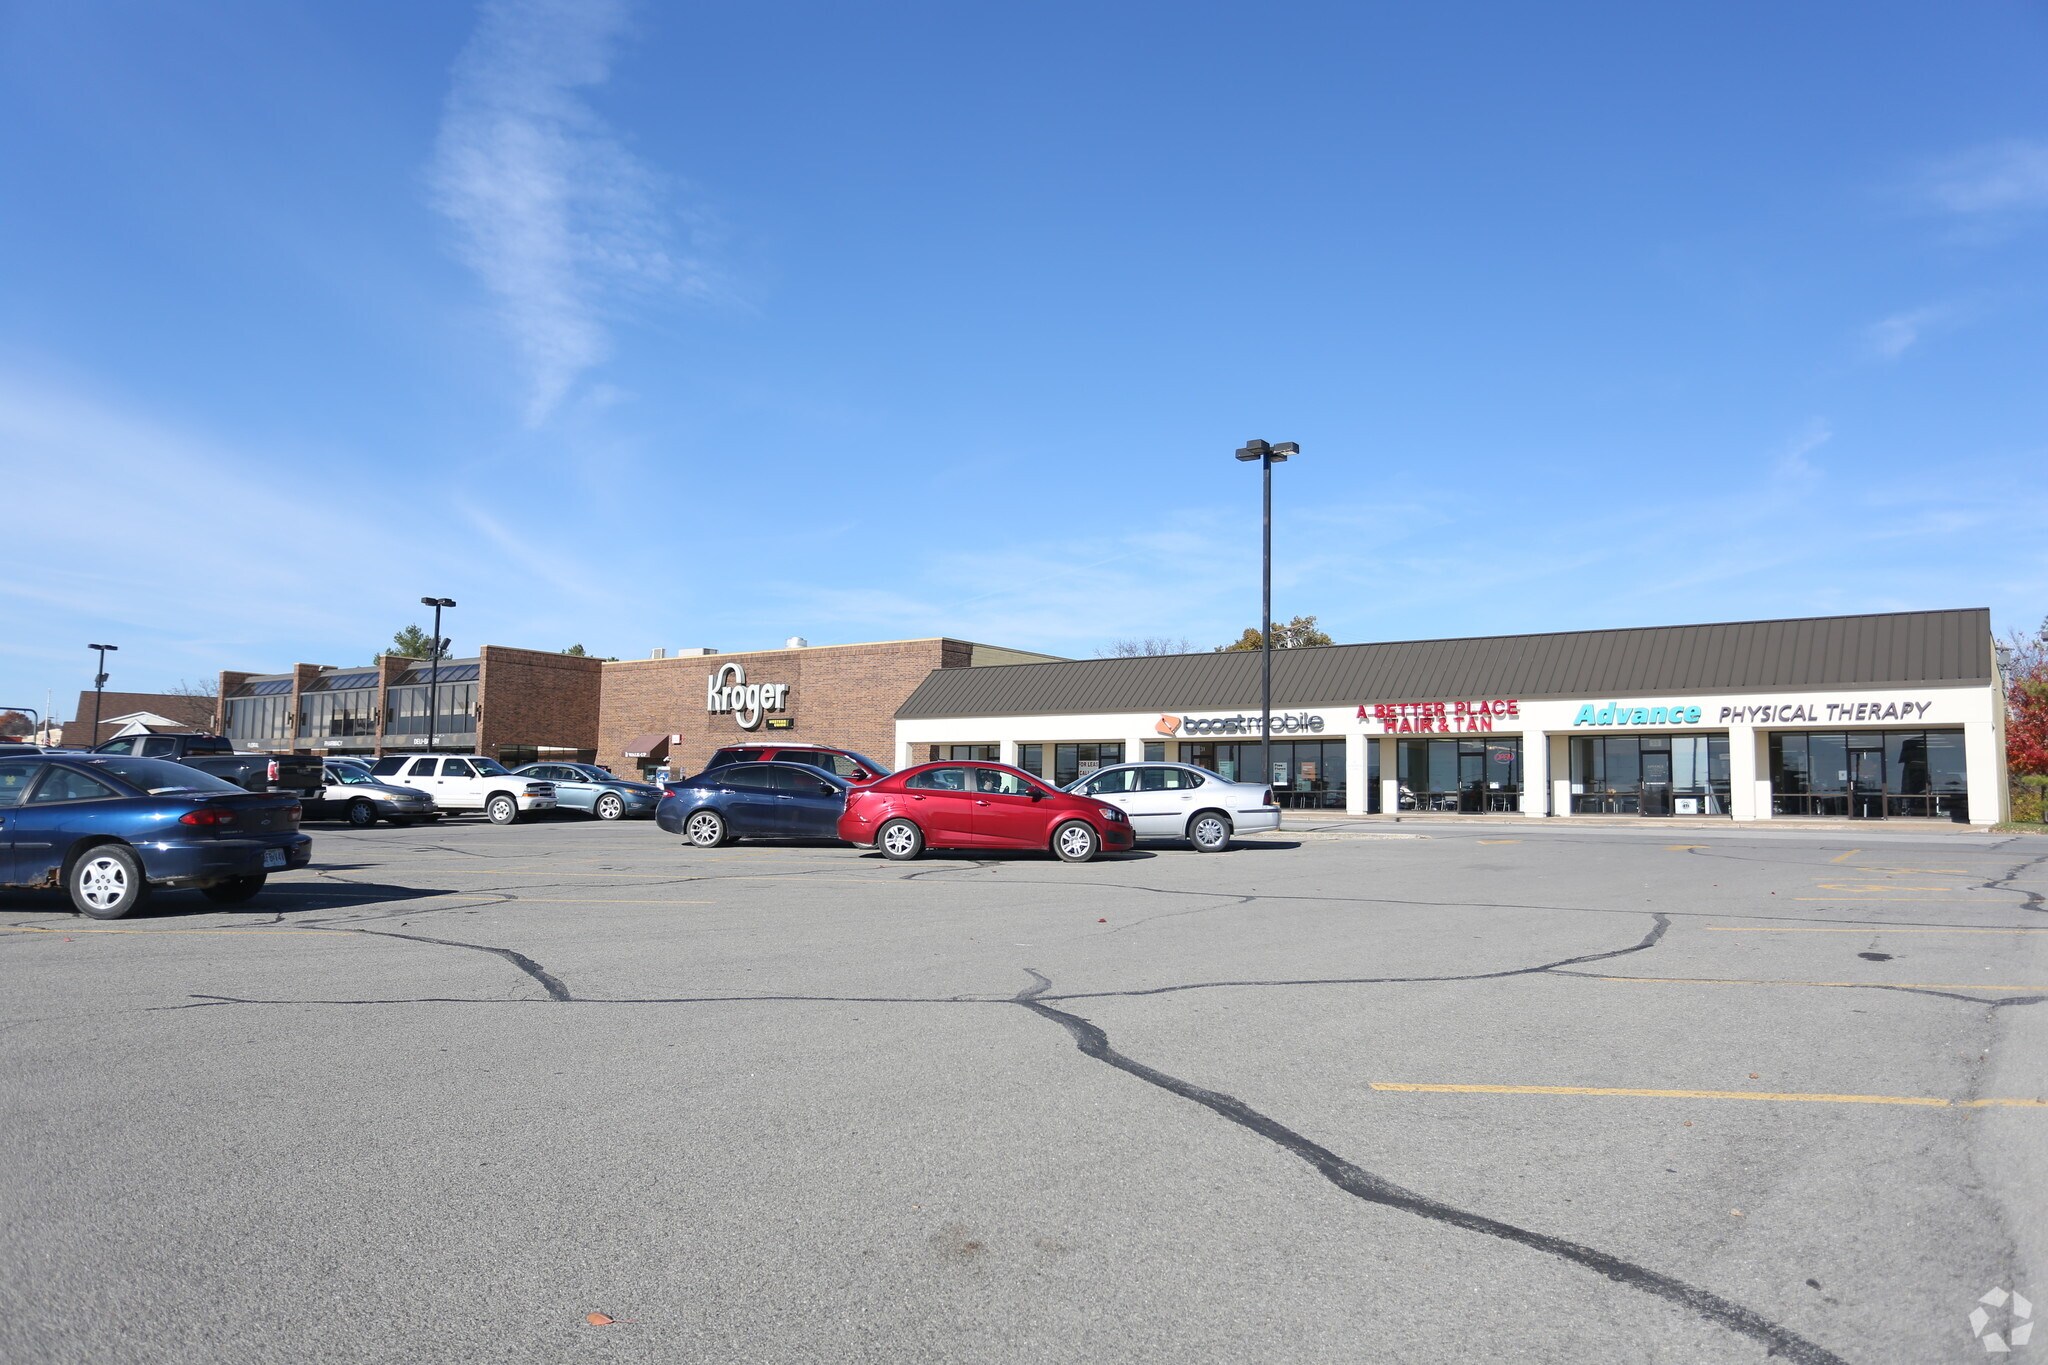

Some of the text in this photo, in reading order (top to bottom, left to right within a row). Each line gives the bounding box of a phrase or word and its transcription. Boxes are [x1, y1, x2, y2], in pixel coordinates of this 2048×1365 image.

[707, 662, 789, 729] Kroger
[1356, 699, 1519, 719] A BETTER PLACE
[1573, 701, 1932, 726] Advance PHYSICAL THERAPY
[1383, 715, 1493, 733] HAIR & TAN
